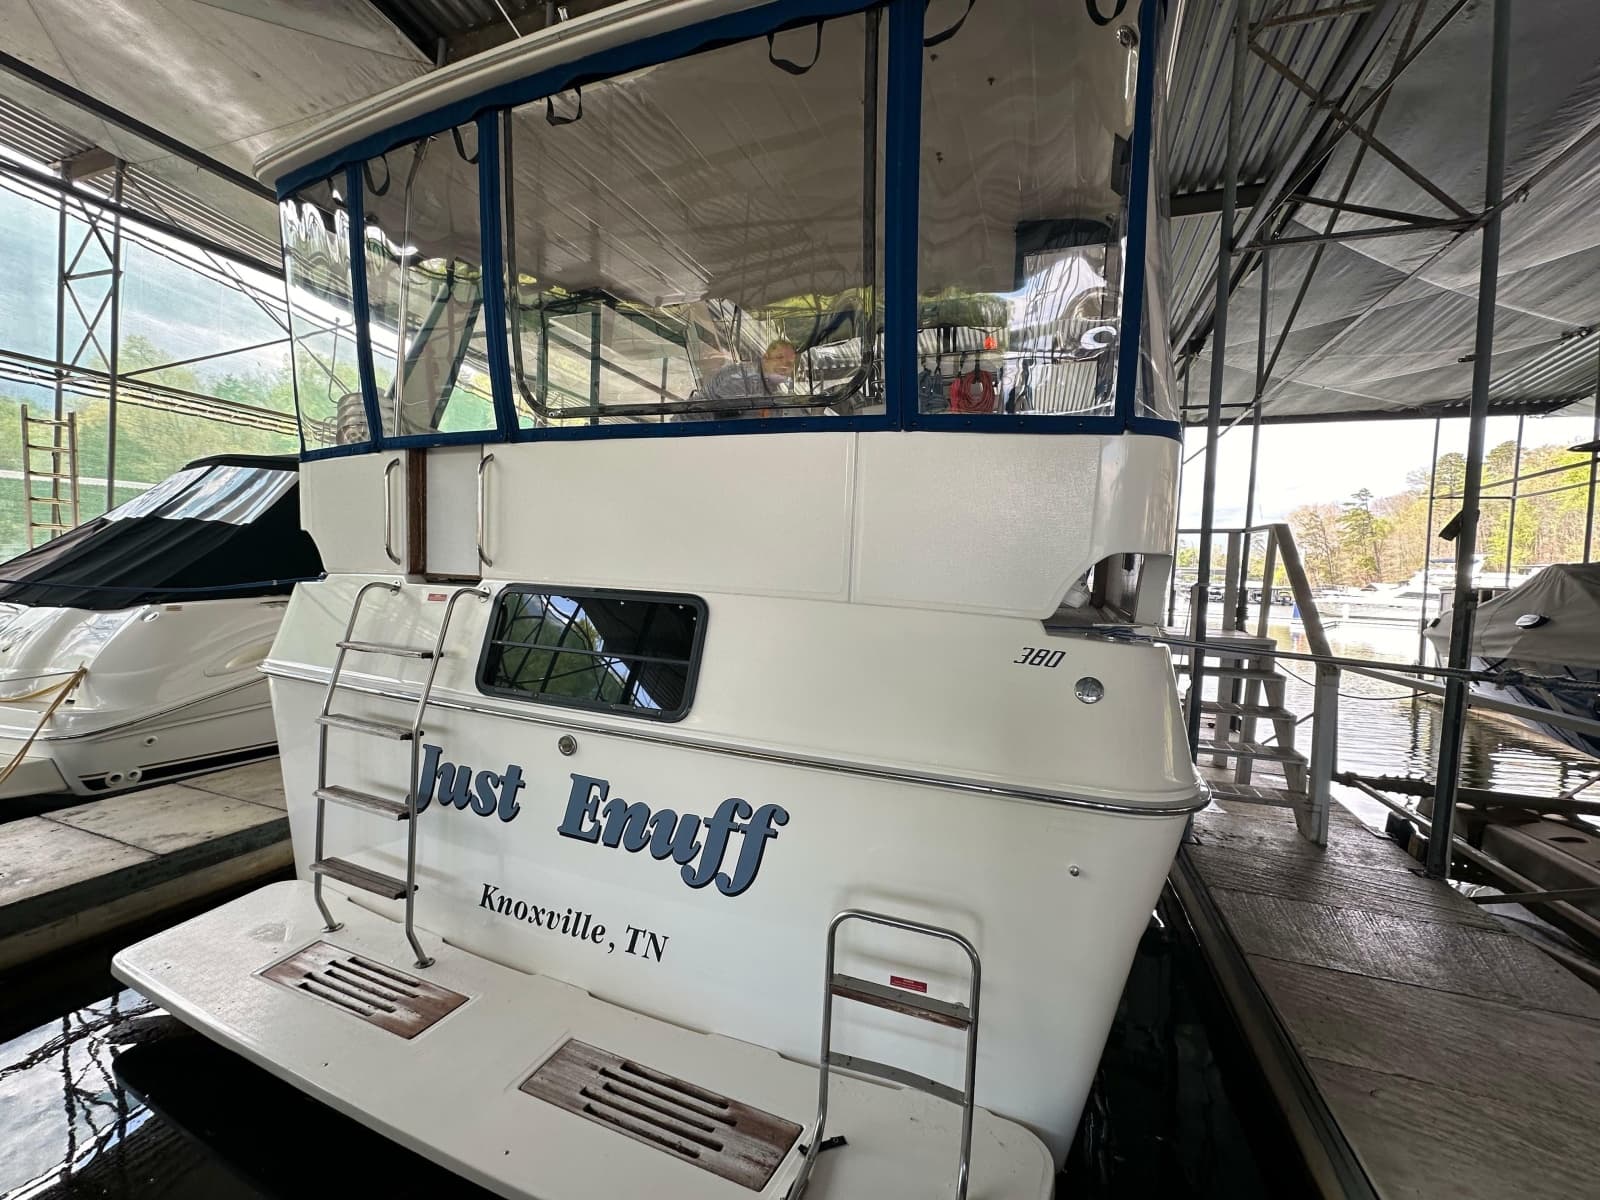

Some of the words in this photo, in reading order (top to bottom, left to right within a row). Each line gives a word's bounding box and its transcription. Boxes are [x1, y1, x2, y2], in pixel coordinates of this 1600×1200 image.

[1013, 647, 1066, 667] 380
[405, 744, 526, 822] Just
[557, 773, 790, 897] Enuff
[478, 883, 615, 954] Knoxville,
[625, 924, 670, 963] TN
